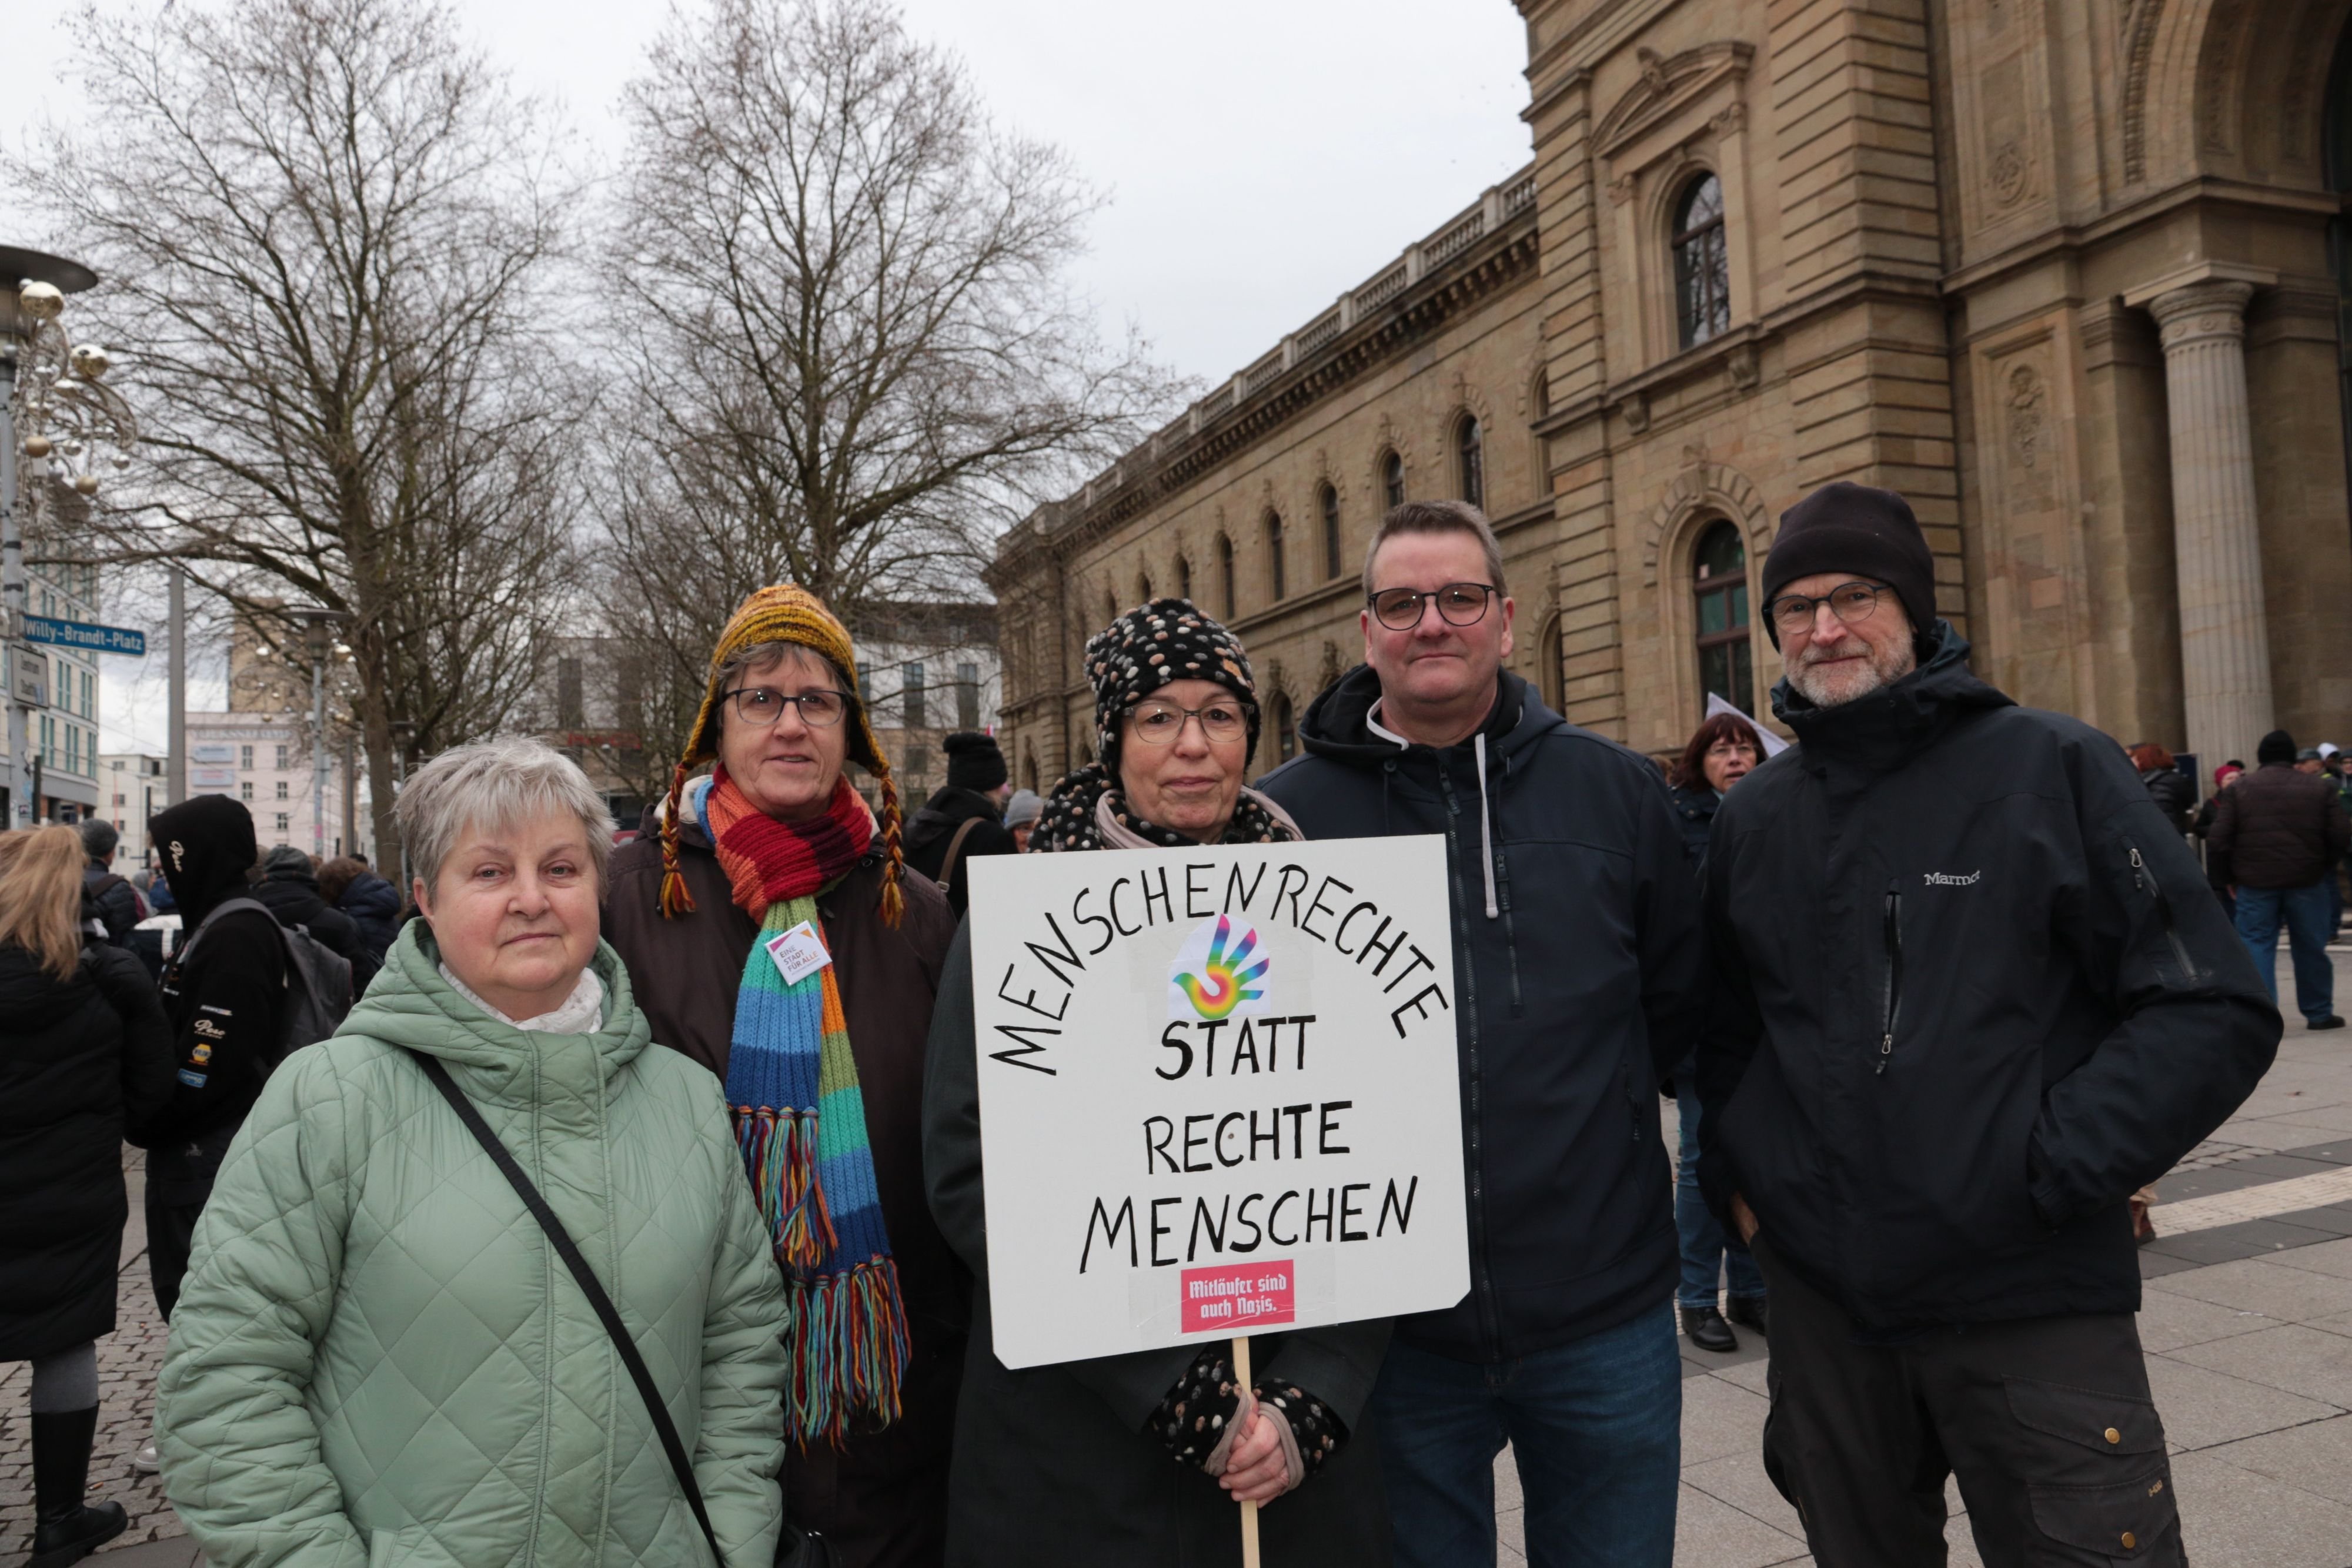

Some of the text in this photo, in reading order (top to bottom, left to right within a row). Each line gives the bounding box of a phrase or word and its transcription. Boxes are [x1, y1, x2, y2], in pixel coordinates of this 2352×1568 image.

[25, 619, 142, 650] Willy-Brandt-Platz
[780, 945, 797, 958] EINE
[783, 949, 804, 965] STADT
[788, 961, 802, 972] FÜR
[802, 951, 818, 964] ALLE
[988, 861, 1449, 1076] MENSCHENRECHTE
[1155, 1015, 1316, 1081] STATT
[1143, 1101, 1353, 1175] RECHTE
[1080, 1176, 1418, 1274] MENSCHEN
[1190, 1273, 1287, 1299] Mitläufer sind
[1201, 1295, 1277, 1318] auch Nazis.
